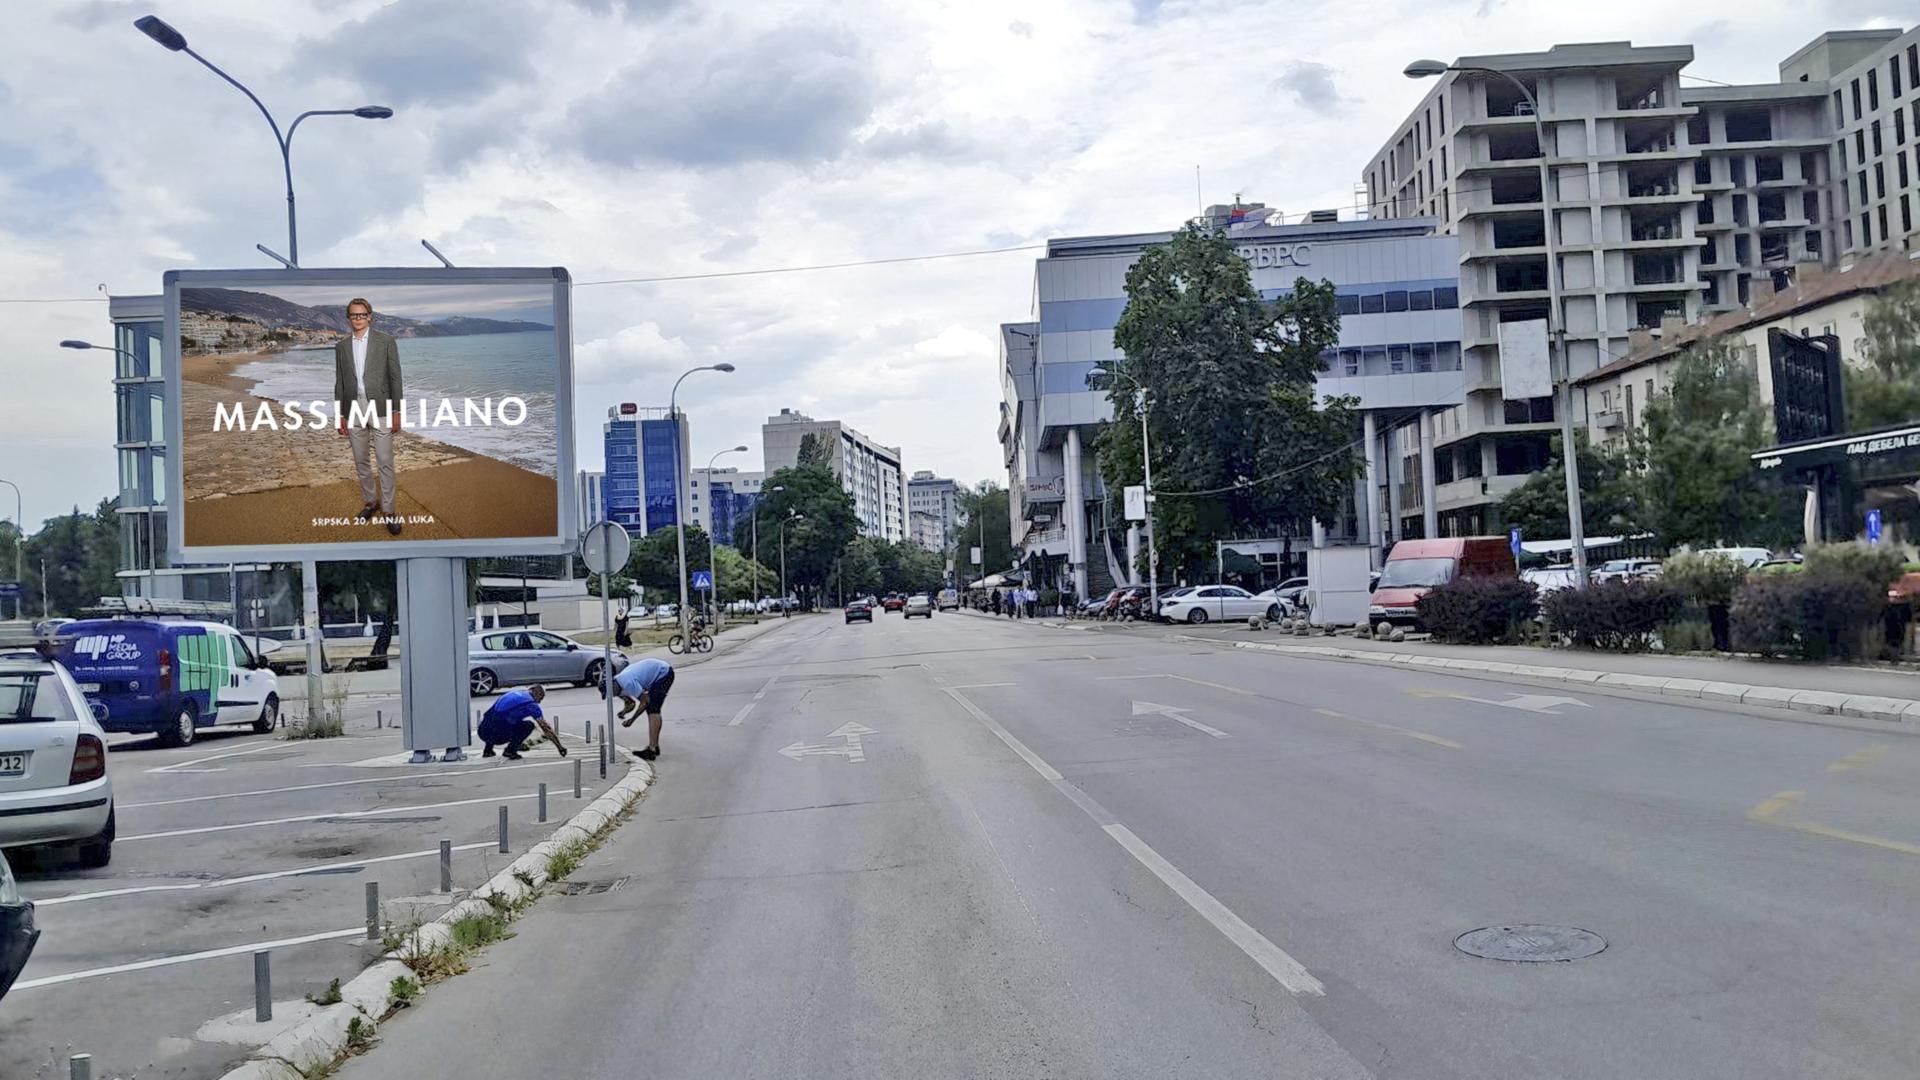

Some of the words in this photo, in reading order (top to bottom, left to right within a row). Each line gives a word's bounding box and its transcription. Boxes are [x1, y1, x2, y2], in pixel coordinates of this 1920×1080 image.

[1233, 246, 1311, 267] РБРС
[213, 397, 527, 432] MASSIMILIANO
[1846, 442, 1867, 454] ПАБ
[1867, 436, 1906, 454] ДЕБЕЛА
[312, 517, 350, 526] SRPSKA
[354, 517, 369, 526] 20,
[372, 515, 405, 525] BANJA
[408, 515, 434, 524] LUKA
[108, 643, 137, 652] MEDIA
[106, 651, 141, 660] GROUP
[0, 757, 21, 770] 12
